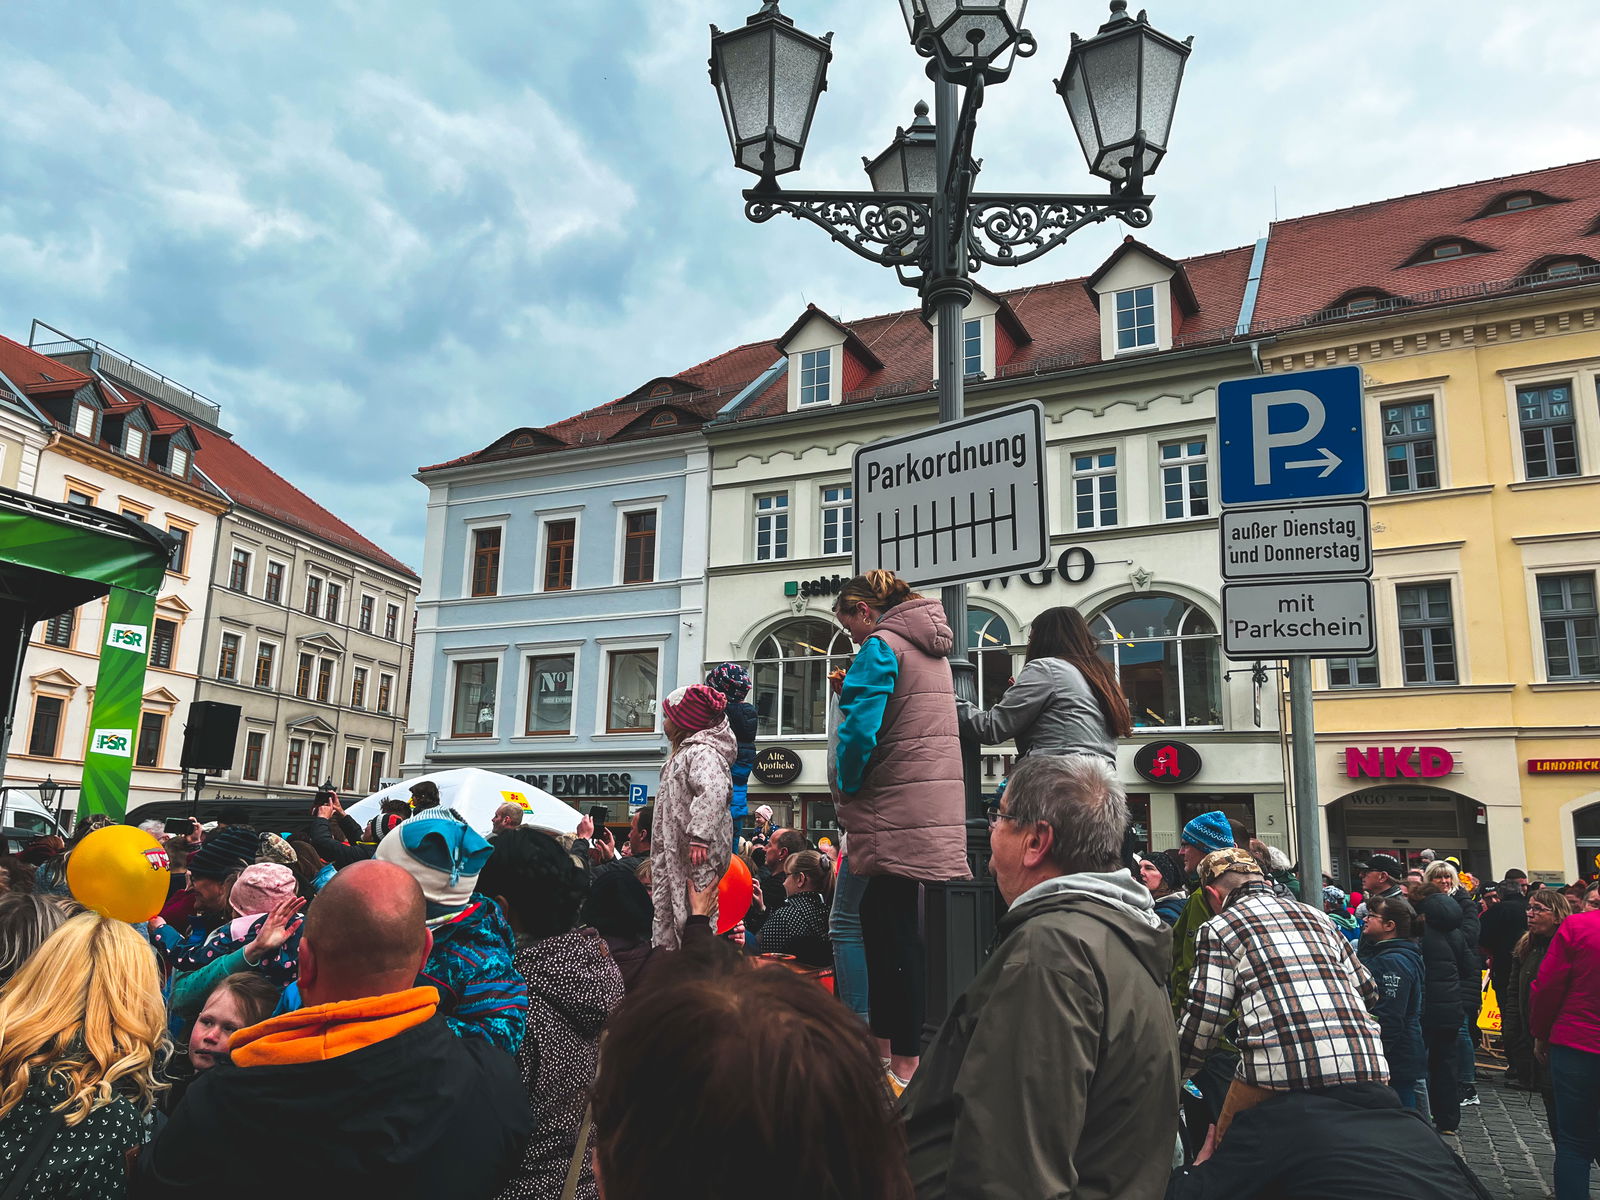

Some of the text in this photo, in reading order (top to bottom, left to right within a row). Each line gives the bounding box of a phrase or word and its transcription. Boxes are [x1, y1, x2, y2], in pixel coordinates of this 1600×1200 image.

[1251, 389, 1326, 486] P
[867, 433, 1027, 493] Parkordnung
[1231, 518, 1356, 541] außer Dienstag
[1229, 541, 1360, 564] und Donnerstag
[1278, 593, 1315, 613] mit
[115, 629, 143, 647] PSR
[1234, 617, 1362, 639] Parkschein
[100, 734, 127, 751] PSR
[756, 761, 795, 771] Apotheke
[767, 752, 785, 761] Alte
[1345, 746, 1454, 778] NKD
[552, 773, 633, 796] EXPRESS
[632, 787, 643, 802] P
[1267, 815, 1275, 826] 5
